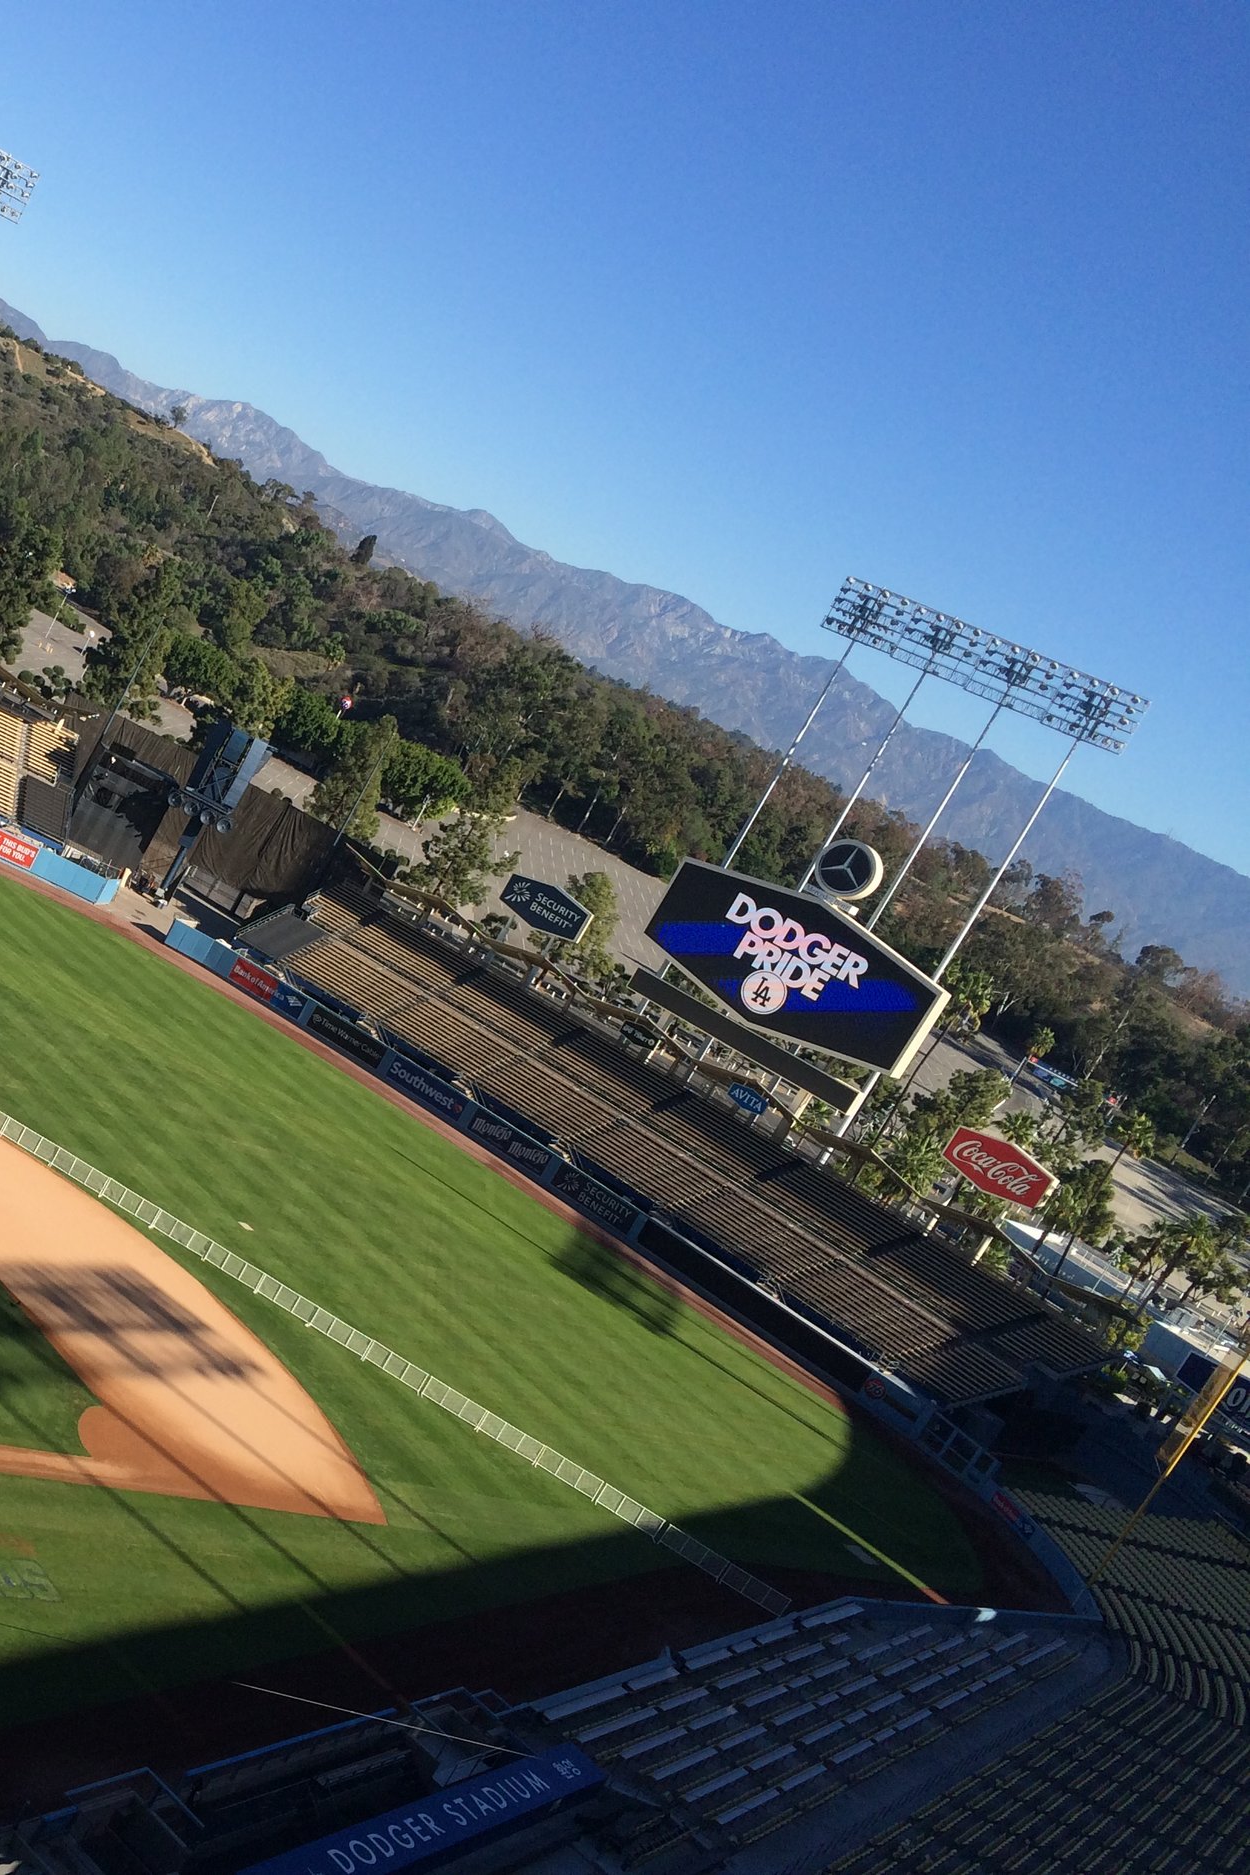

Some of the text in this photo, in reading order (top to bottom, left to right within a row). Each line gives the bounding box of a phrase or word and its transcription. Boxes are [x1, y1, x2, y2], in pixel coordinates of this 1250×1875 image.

[2, 837, 36, 858] THIS BUD'S
[529, 901, 570, 929] BENEFIT
[535, 892, 582, 922] SECURITY
[725, 892, 869, 989] DODGER
[732, 931, 831, 1001] PRIDE
[233, 964, 251, 980] Bank
[257, 980, 285, 1001] America
[751, 977, 771, 1007] LA
[321, 1018, 338, 1034] Time
[337, 1027, 362, 1047] Warner
[390, 1061, 455, 1110] Southwest
[730, 1087, 763, 1112] AVITA
[952, 1140, 1042, 1196] Coca-Cola
[577, 1192, 620, 1224] BENEFIT
[584, 1181, 633, 1218] SECURITY
[867, 1381, 884, 1398] 76
[327, 1768, 551, 1875] DODGER STADIUM
